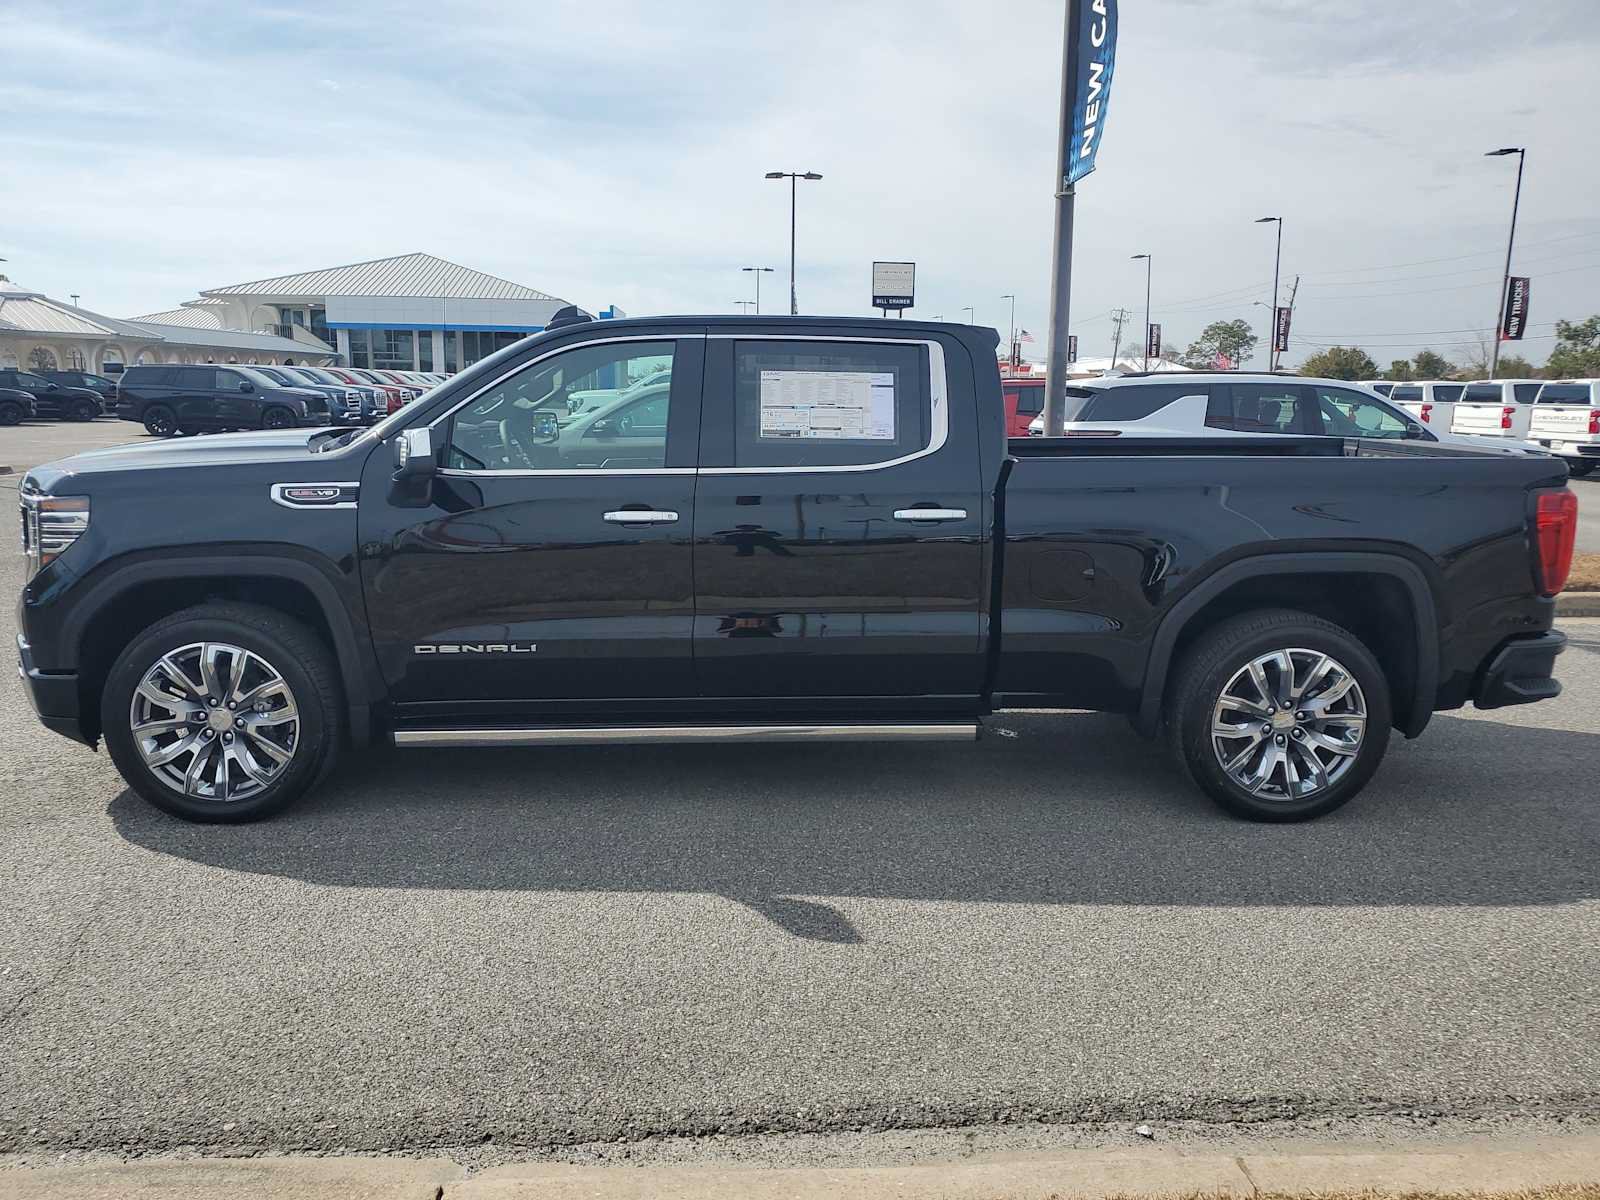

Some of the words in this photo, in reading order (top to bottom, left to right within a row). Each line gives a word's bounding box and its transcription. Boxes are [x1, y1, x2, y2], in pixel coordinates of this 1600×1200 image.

[1080, 62, 1105, 159] NEW
[1511, 280, 1523, 316] TRUCKS
[1508, 316, 1520, 337] NEW
[414, 644, 537, 654] DENALI
